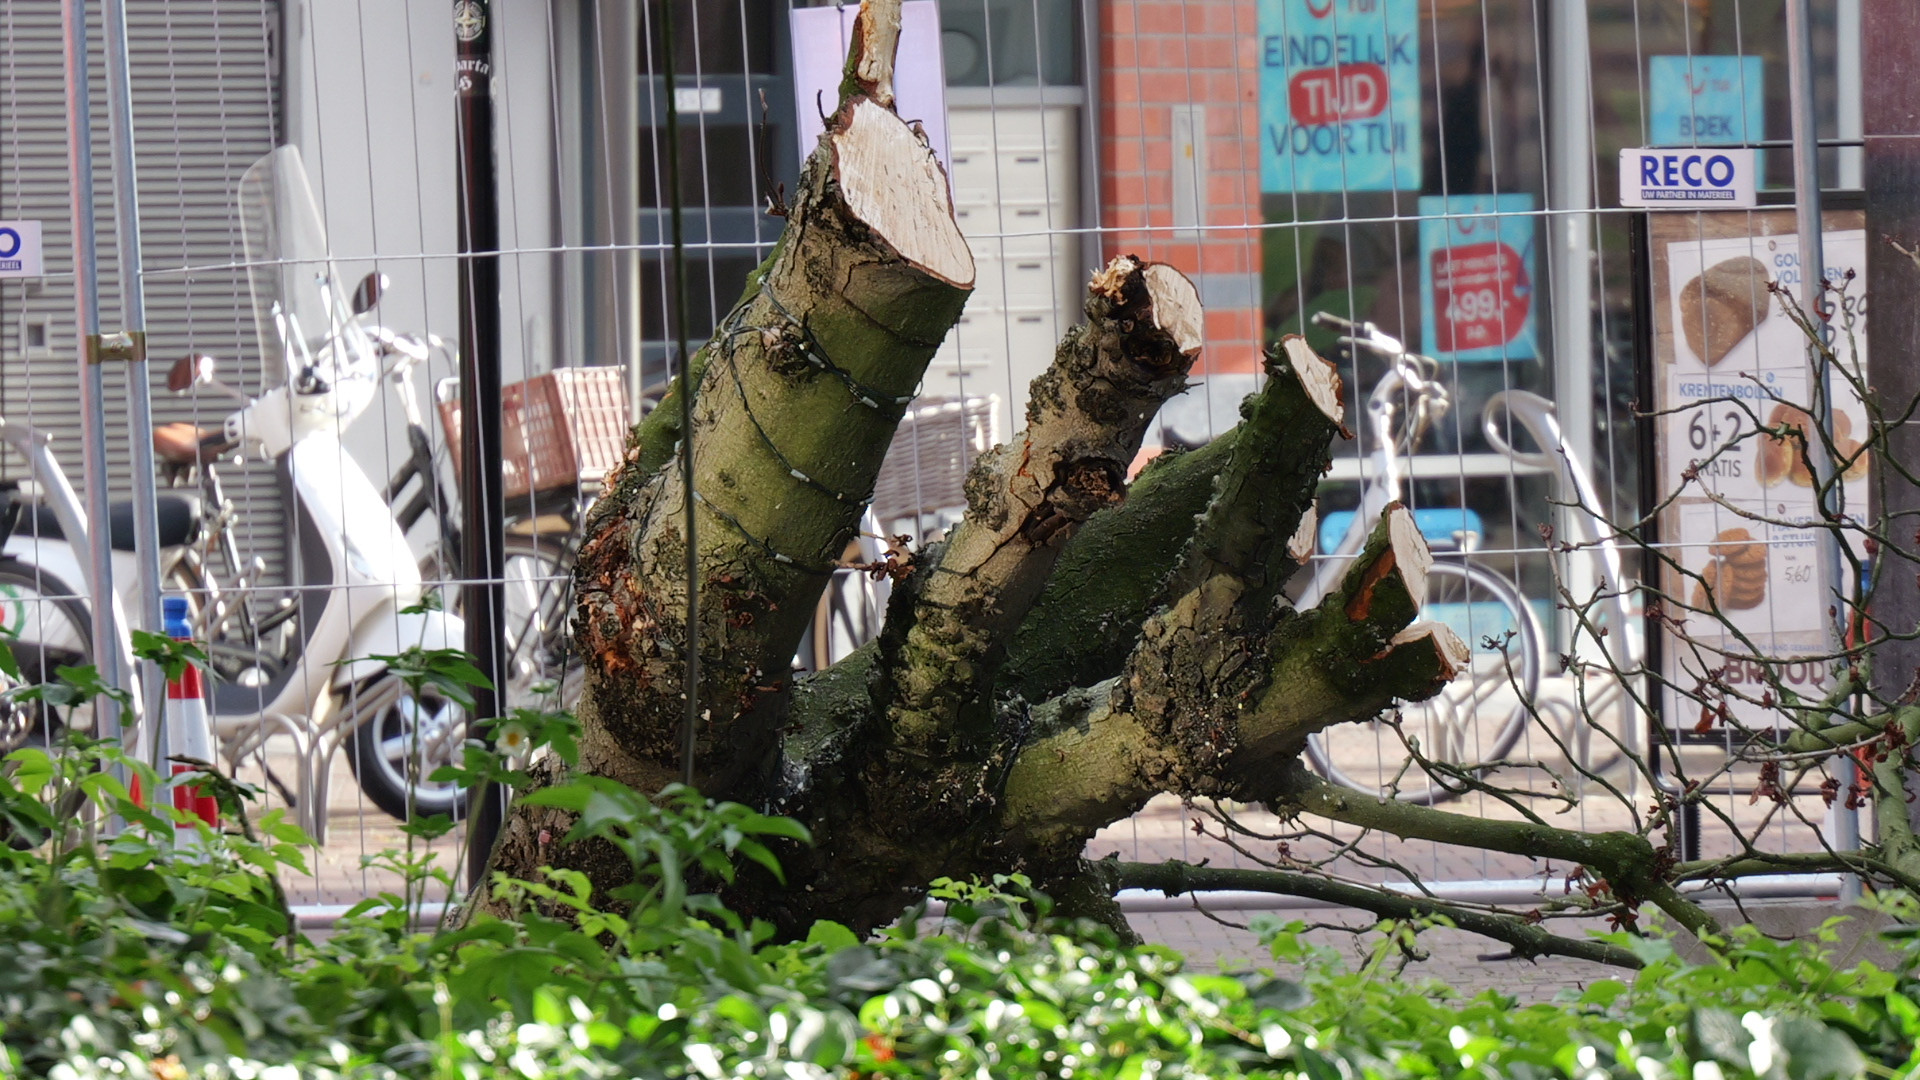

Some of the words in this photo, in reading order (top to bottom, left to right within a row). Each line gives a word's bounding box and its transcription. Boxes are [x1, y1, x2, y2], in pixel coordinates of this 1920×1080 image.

[1301, 73, 1377, 117] TIJD
[1269, 123, 1357, 156] VOOR
[1361, 122, 1407, 154] TUI
[1679, 115, 1733, 137] BOEK
[1640, 155, 1735, 187] RECO
[1642, 190, 1655, 199] UW
[1656, 190, 1687, 199] PARTNER
[1688, 190, 1697, 199] IN
[1698, 190, 1734, 199] MATERIEEL
